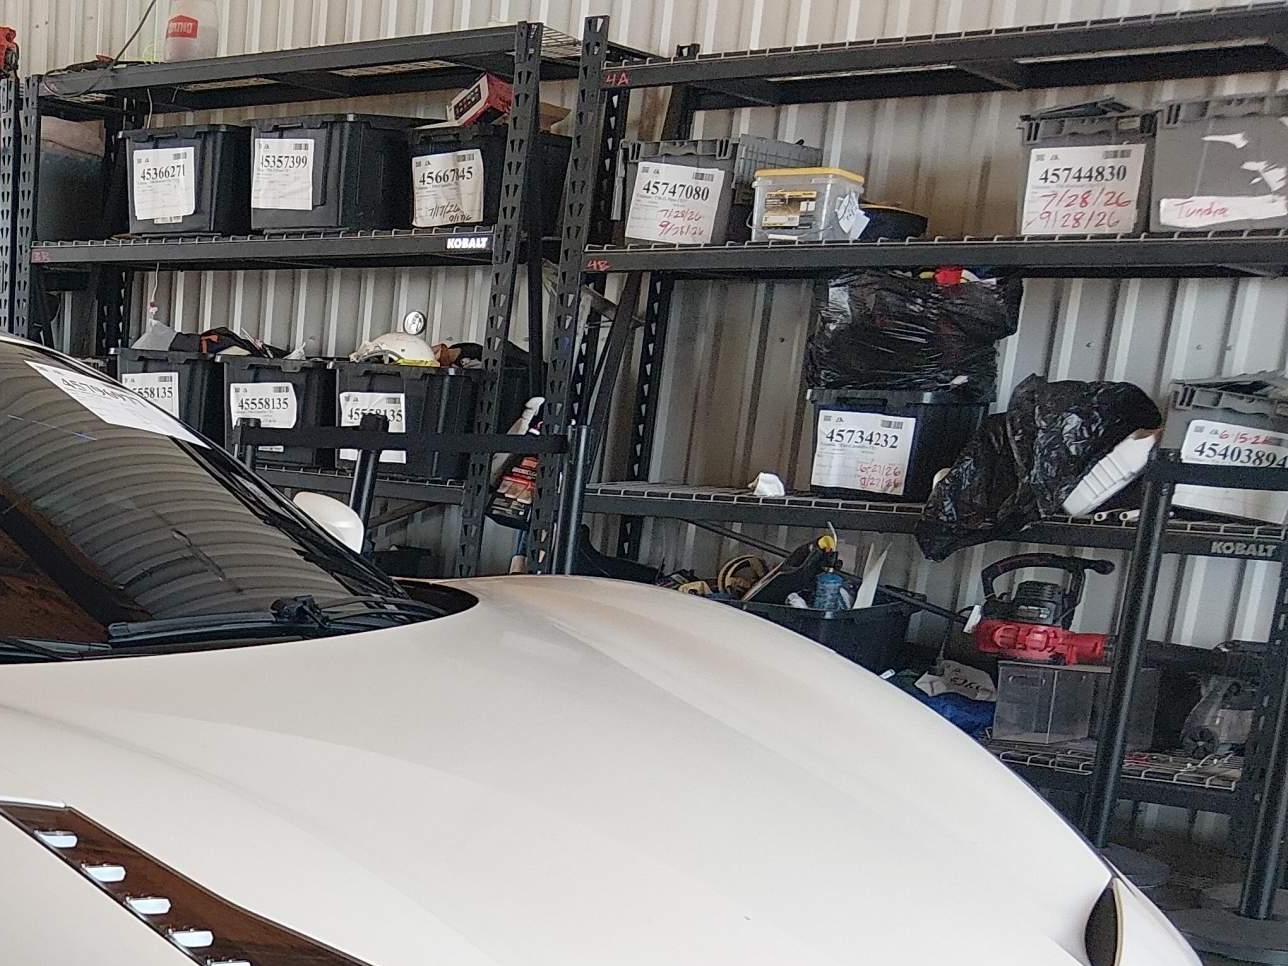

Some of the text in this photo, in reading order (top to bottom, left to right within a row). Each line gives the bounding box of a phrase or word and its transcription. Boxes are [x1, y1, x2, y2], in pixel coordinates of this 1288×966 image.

[1039, 165, 1127, 184] 45744830
[642, 180, 710, 202] 45747080
[1040, 188, 1132, 210] 7/28/26
[1174, 200, 1229, 219] Tundra
[446, 237, 489, 249] KOBALT
[238, 397, 289, 411] 45558135
[825, 428, 899, 449] 45734232
[1193, 440, 1288, 468] 45403894
[1211, 541, 1277, 557] KOBALT
